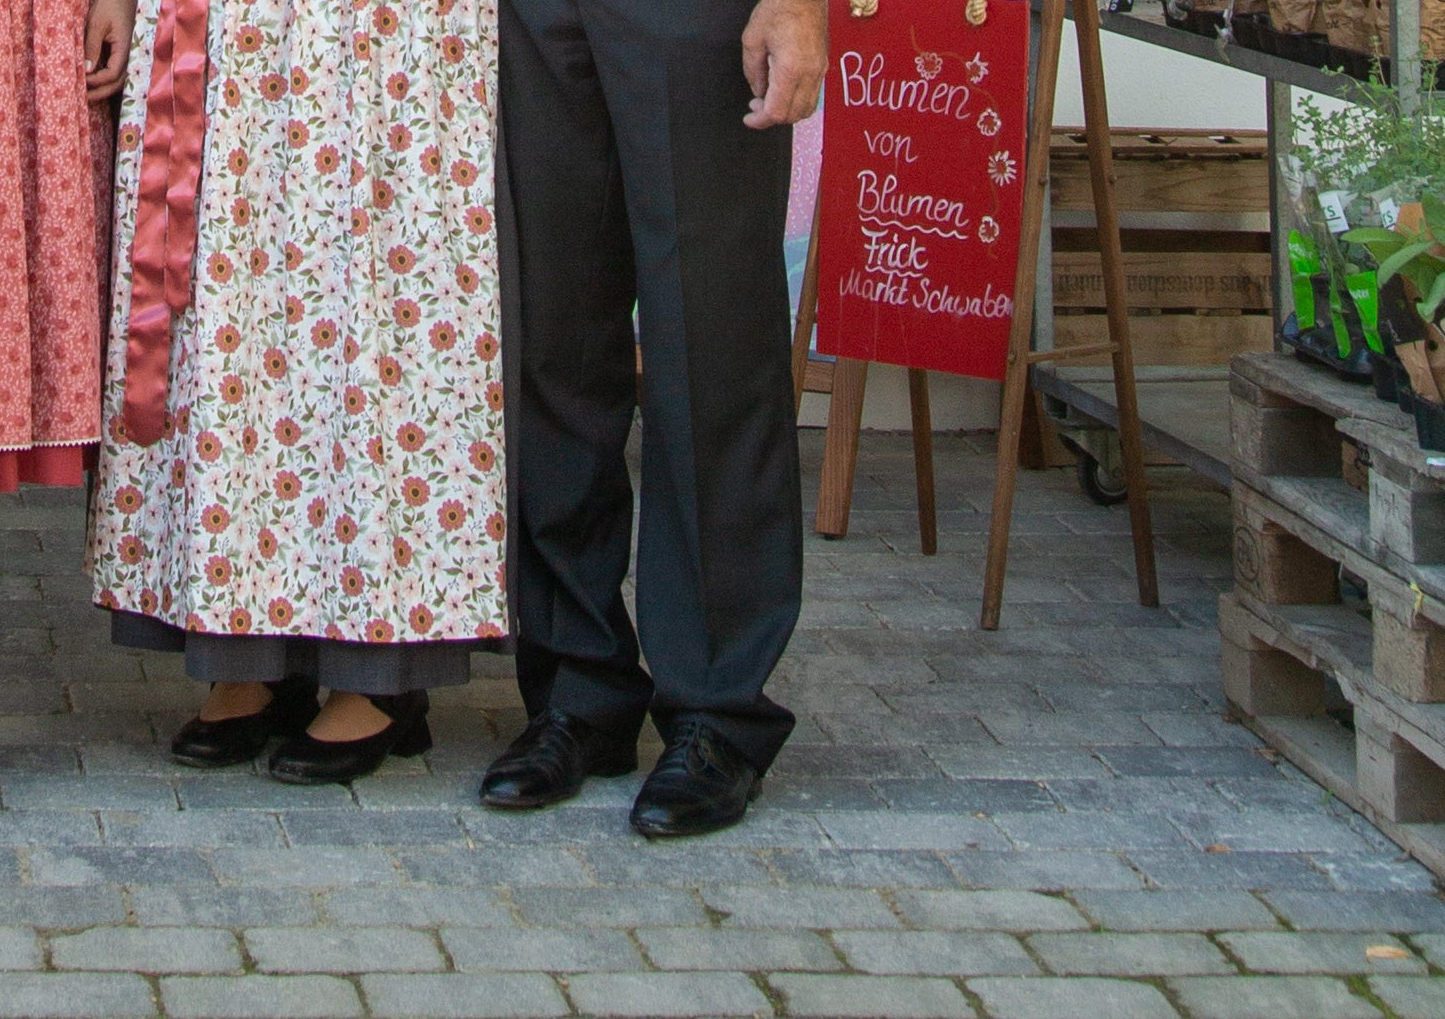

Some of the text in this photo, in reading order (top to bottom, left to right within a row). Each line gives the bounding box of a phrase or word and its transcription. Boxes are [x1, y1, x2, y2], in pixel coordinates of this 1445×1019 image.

[839, 51, 971, 120] Blumen
[864, 130, 919, 164] von
[857, 170, 969, 228] Blumen
[861, 226, 929, 271] Frick
[839, 267, 908, 305] Markt
